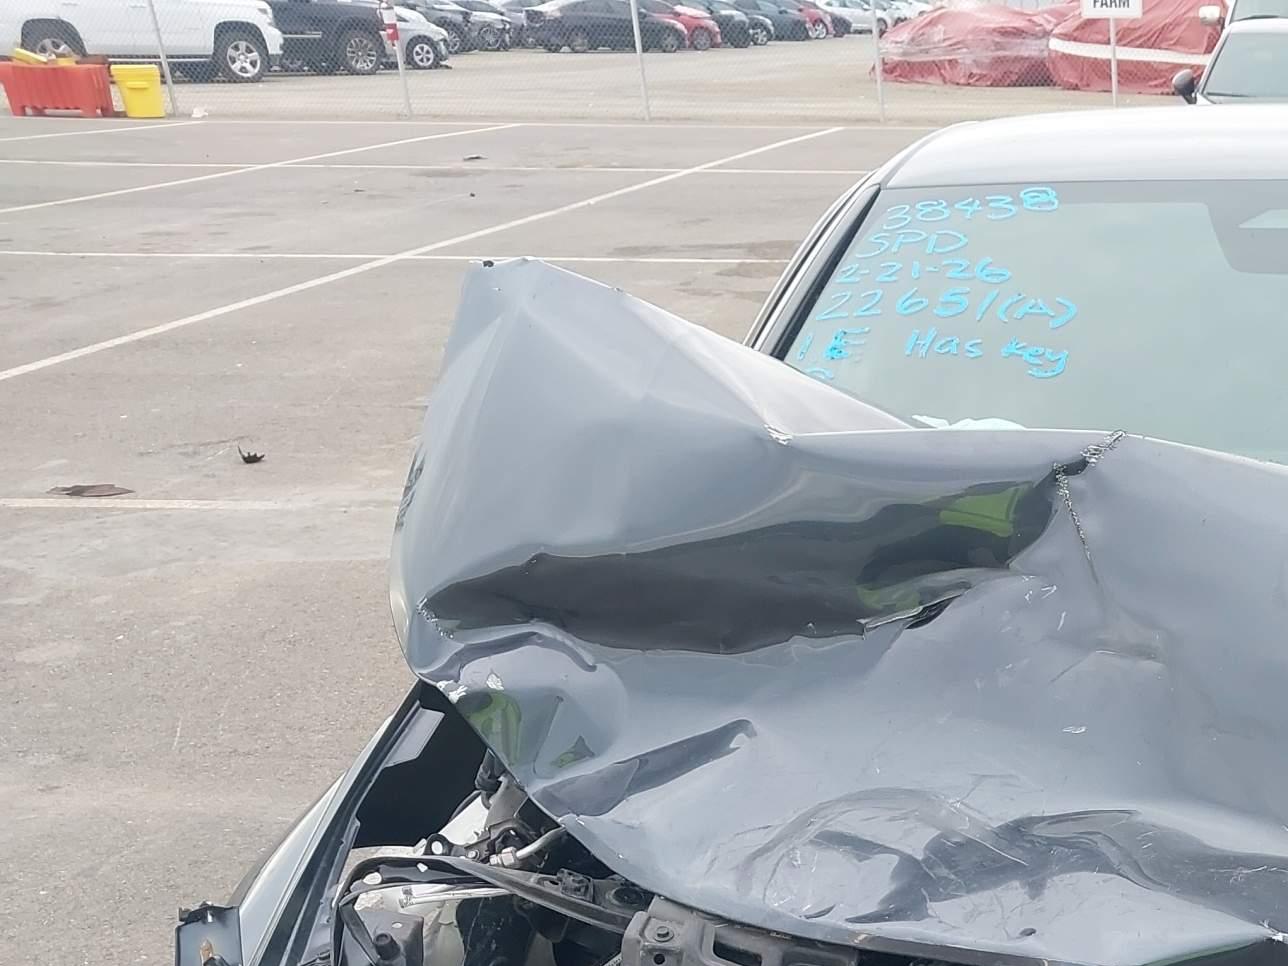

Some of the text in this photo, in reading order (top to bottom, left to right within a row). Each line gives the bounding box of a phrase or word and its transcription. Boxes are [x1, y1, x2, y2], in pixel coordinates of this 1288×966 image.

[885, 187, 1058, 229] 38438
[856, 231, 968, 257] SPD
[905, 328, 983, 358] Has
